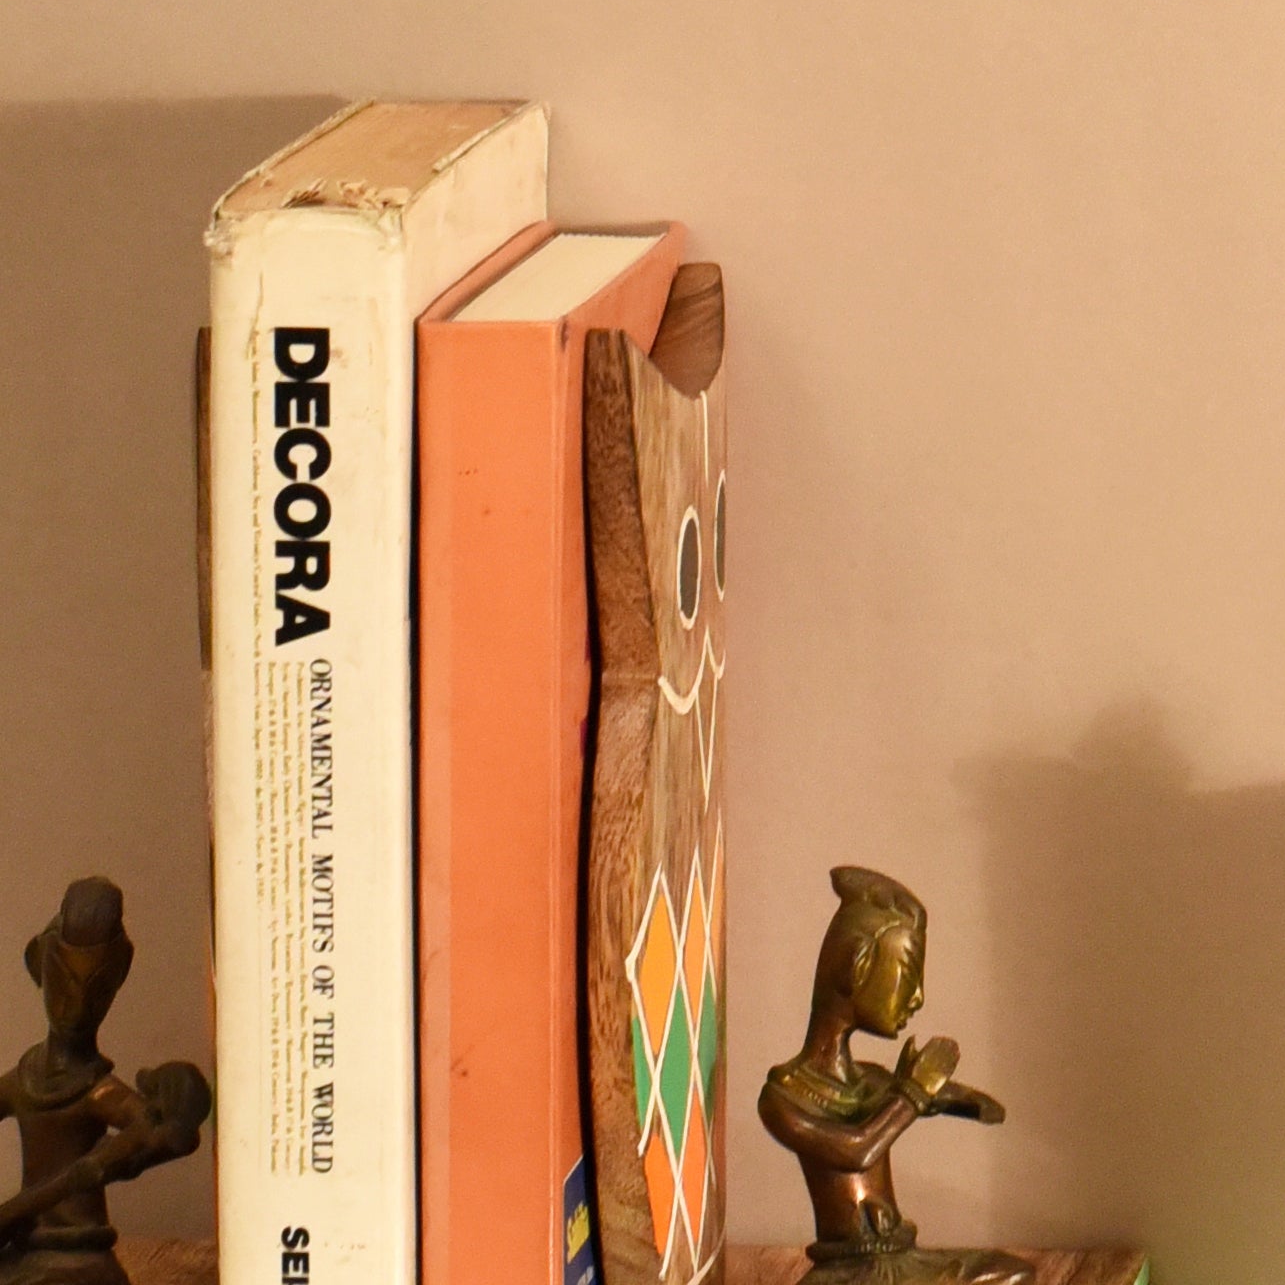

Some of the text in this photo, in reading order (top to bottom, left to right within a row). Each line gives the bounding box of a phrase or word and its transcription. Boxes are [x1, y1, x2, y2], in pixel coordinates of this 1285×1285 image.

[273, 326, 332, 647] DECORA
[310, 658, 335, 1174] ORNAMENTAL MOTIFS OF THE WORLD
